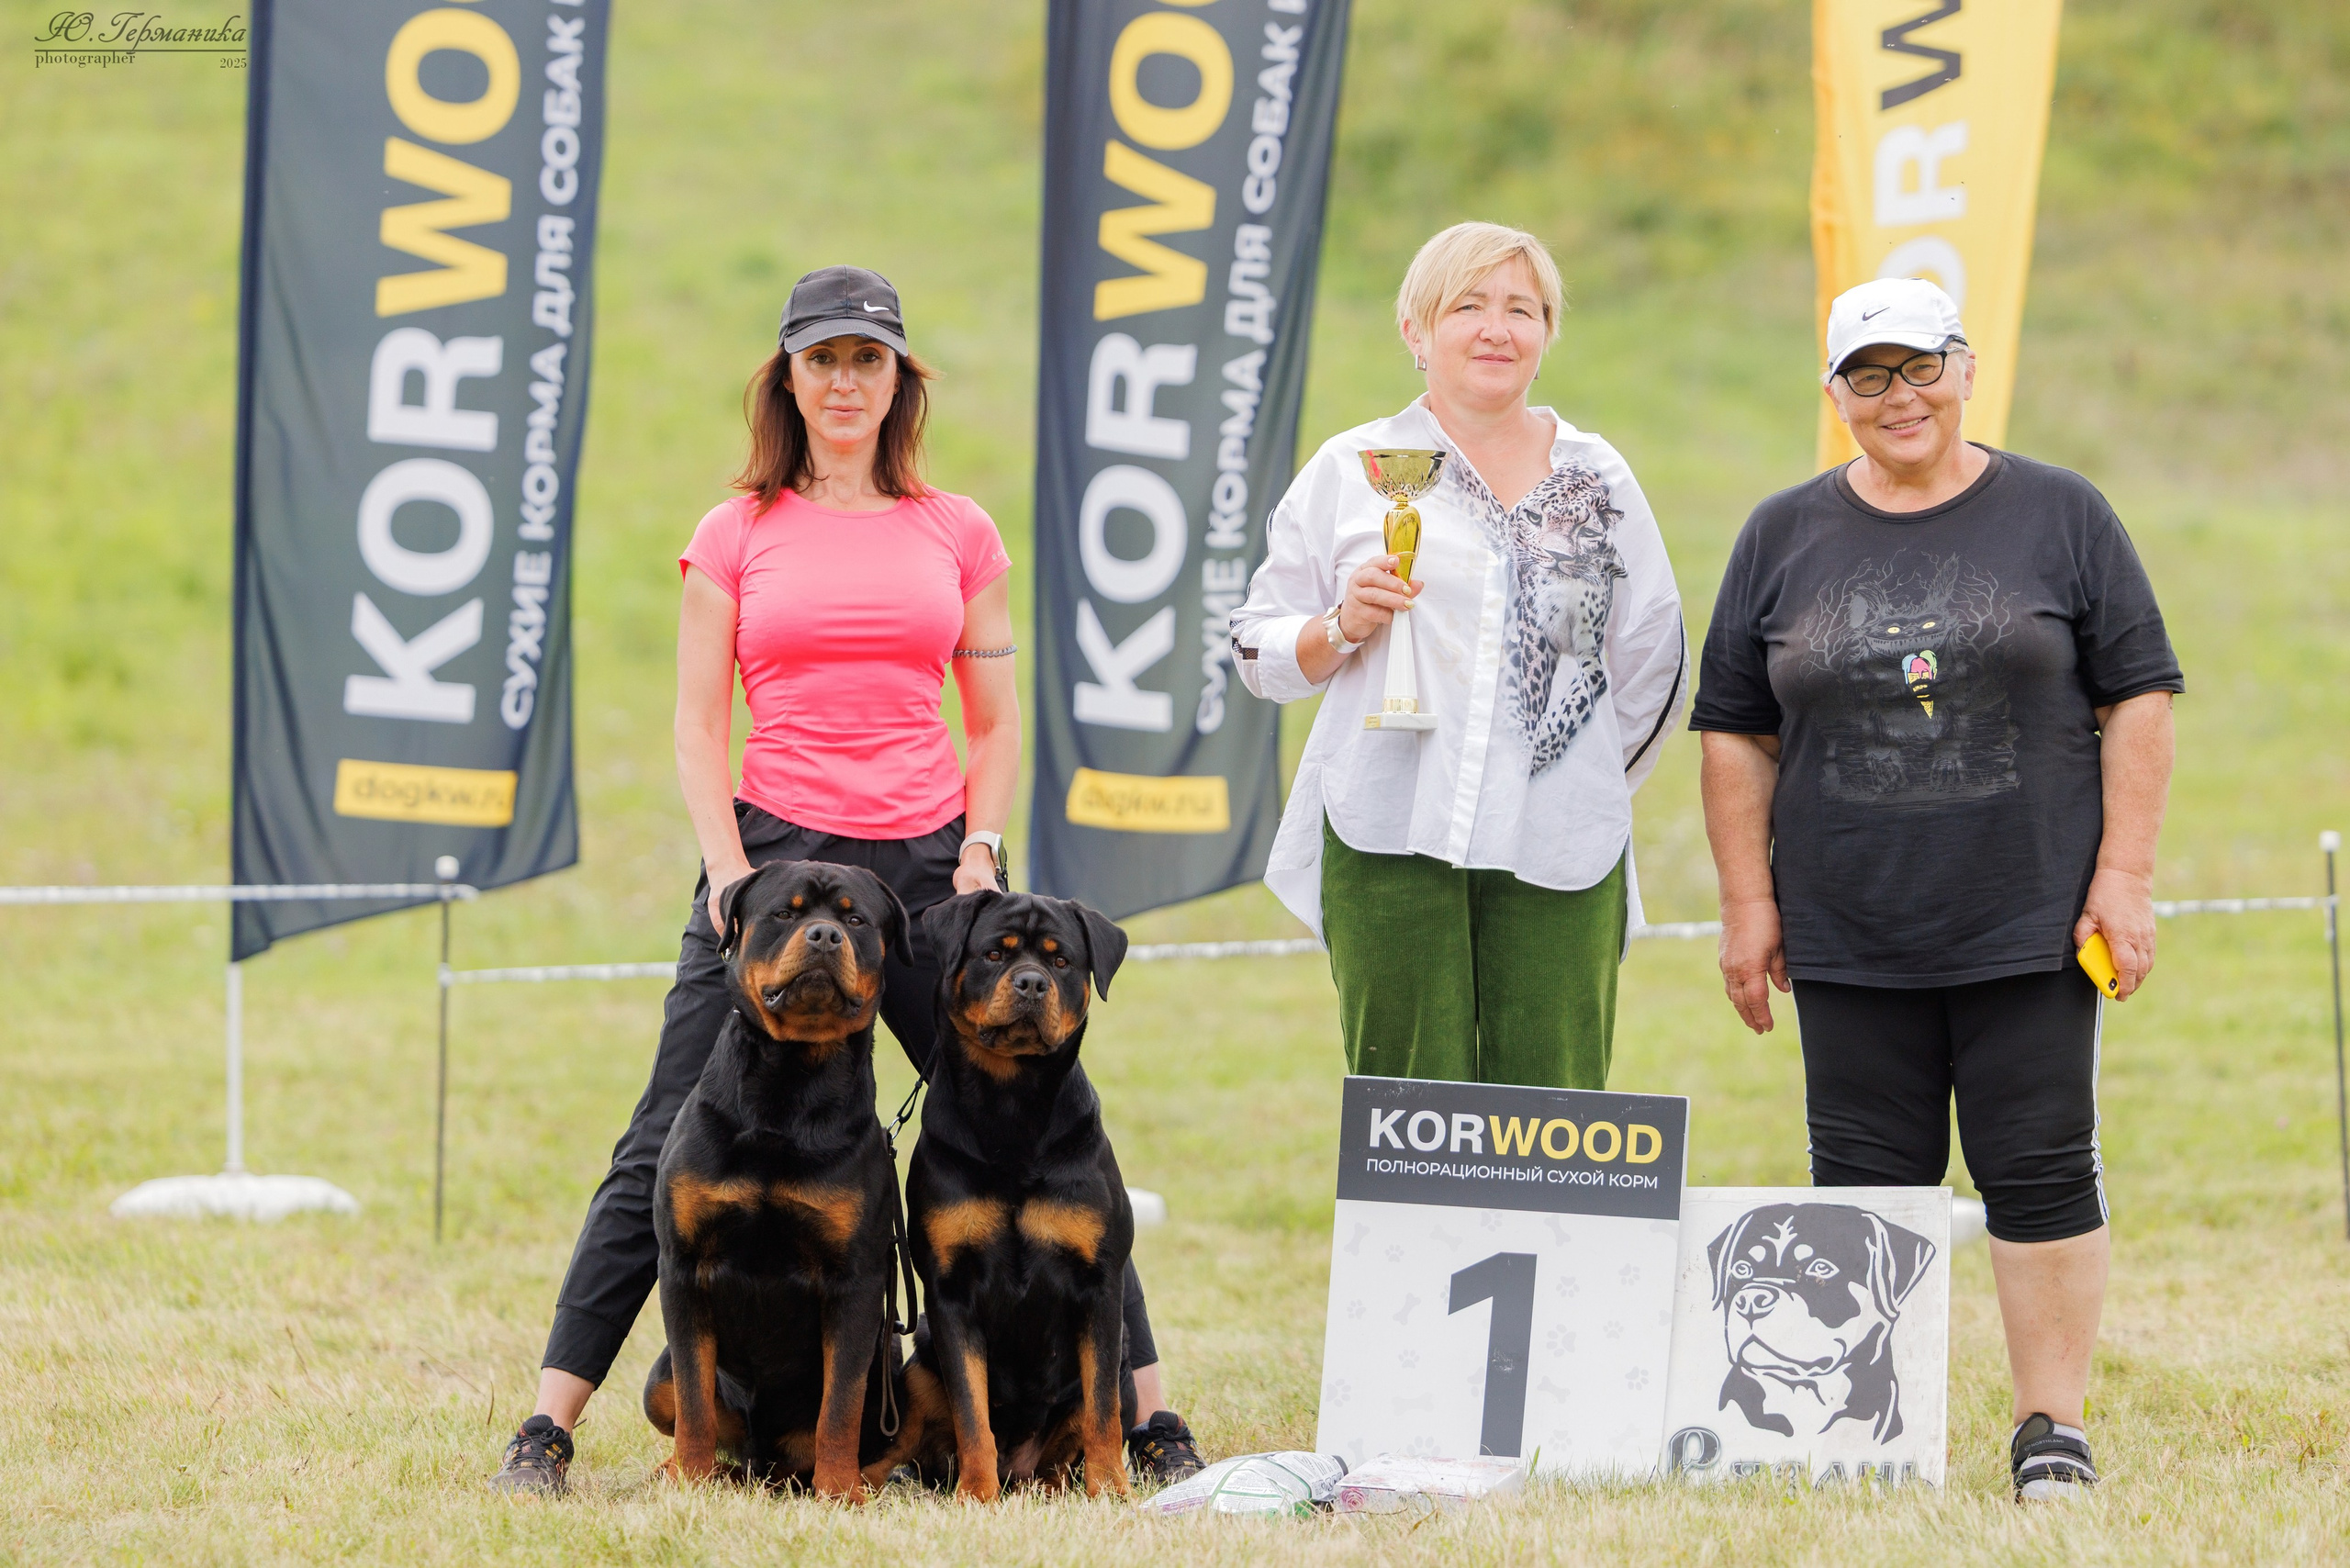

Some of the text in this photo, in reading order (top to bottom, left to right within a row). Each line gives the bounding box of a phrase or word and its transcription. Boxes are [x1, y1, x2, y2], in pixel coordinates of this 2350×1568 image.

[539, 14, 586, 206] СОБАК
[1242, 21, 1304, 214] СОБАК
[343, 0, 521, 724] KORWO
[532, 214, 576, 338] ДЛЯ
[1072, 0, 1235, 733] KORWO
[1224, 223, 1277, 345] ДЛЯ
[517, 342, 568, 541] КОРМА
[1204, 349, 1267, 549] КОРМА
[500, 551, 553, 731] СУХИЕ
[1366, 1158, 1658, 1189] ПОЛНОРАЦИОННЫЙ СУХОЙ КОРМ
[1369, 1108, 1662, 1164] KORWOOD
[1448, 1252, 1538, 1458] 1
